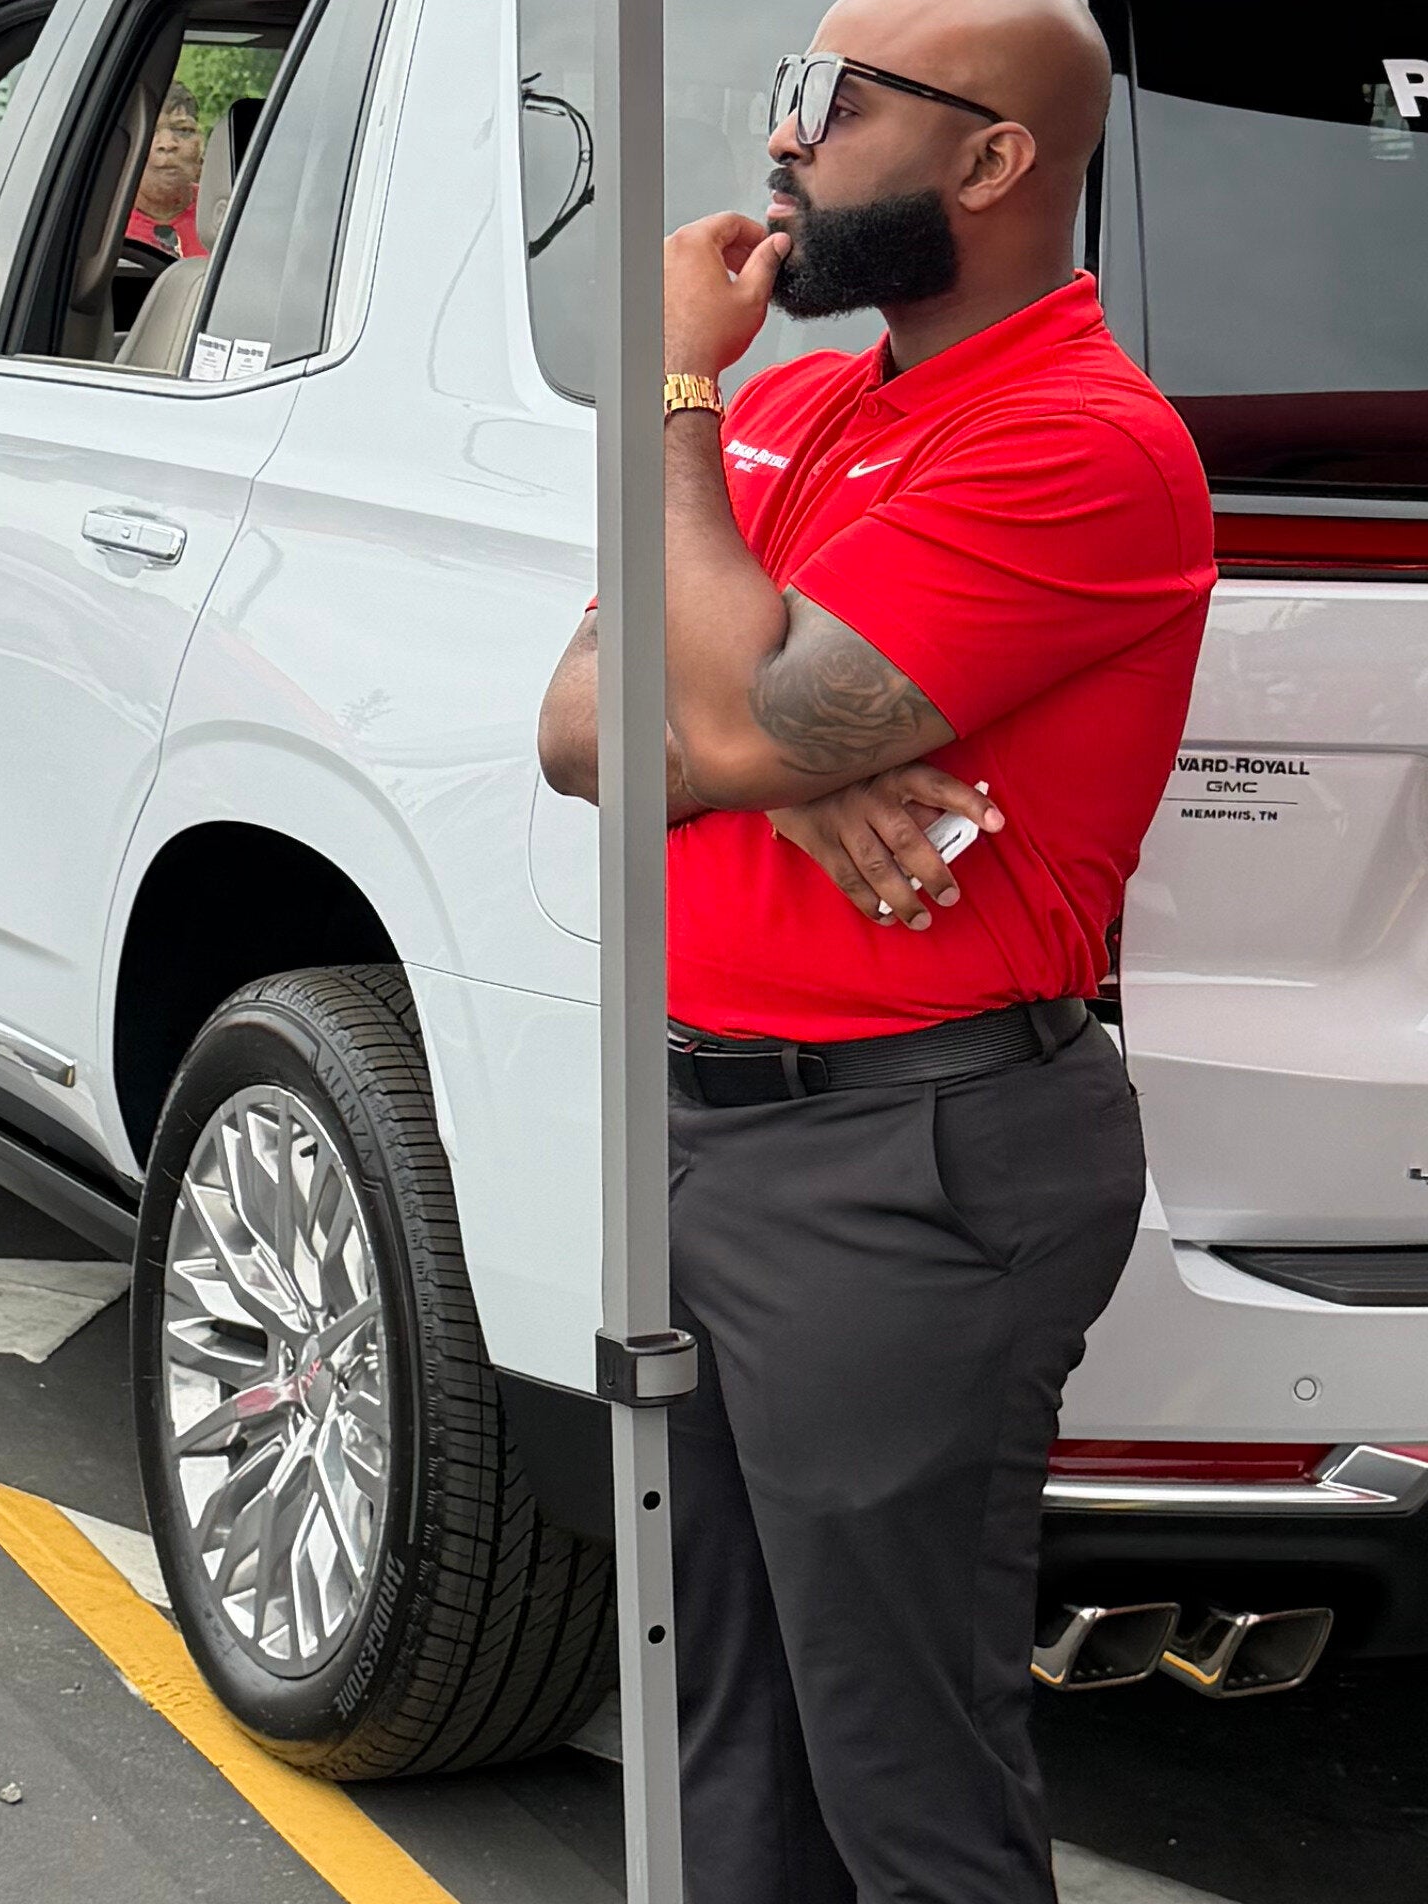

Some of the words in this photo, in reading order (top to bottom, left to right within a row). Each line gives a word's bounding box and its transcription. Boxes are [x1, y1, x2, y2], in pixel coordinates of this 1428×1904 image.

[1206, 781, 1258, 794] GMC
[1180, 808, 1256, 822] MEMPHIS,
[1258, 810, 1278, 821] TN
[332, 1548, 407, 1720] BRIDGESTONE
